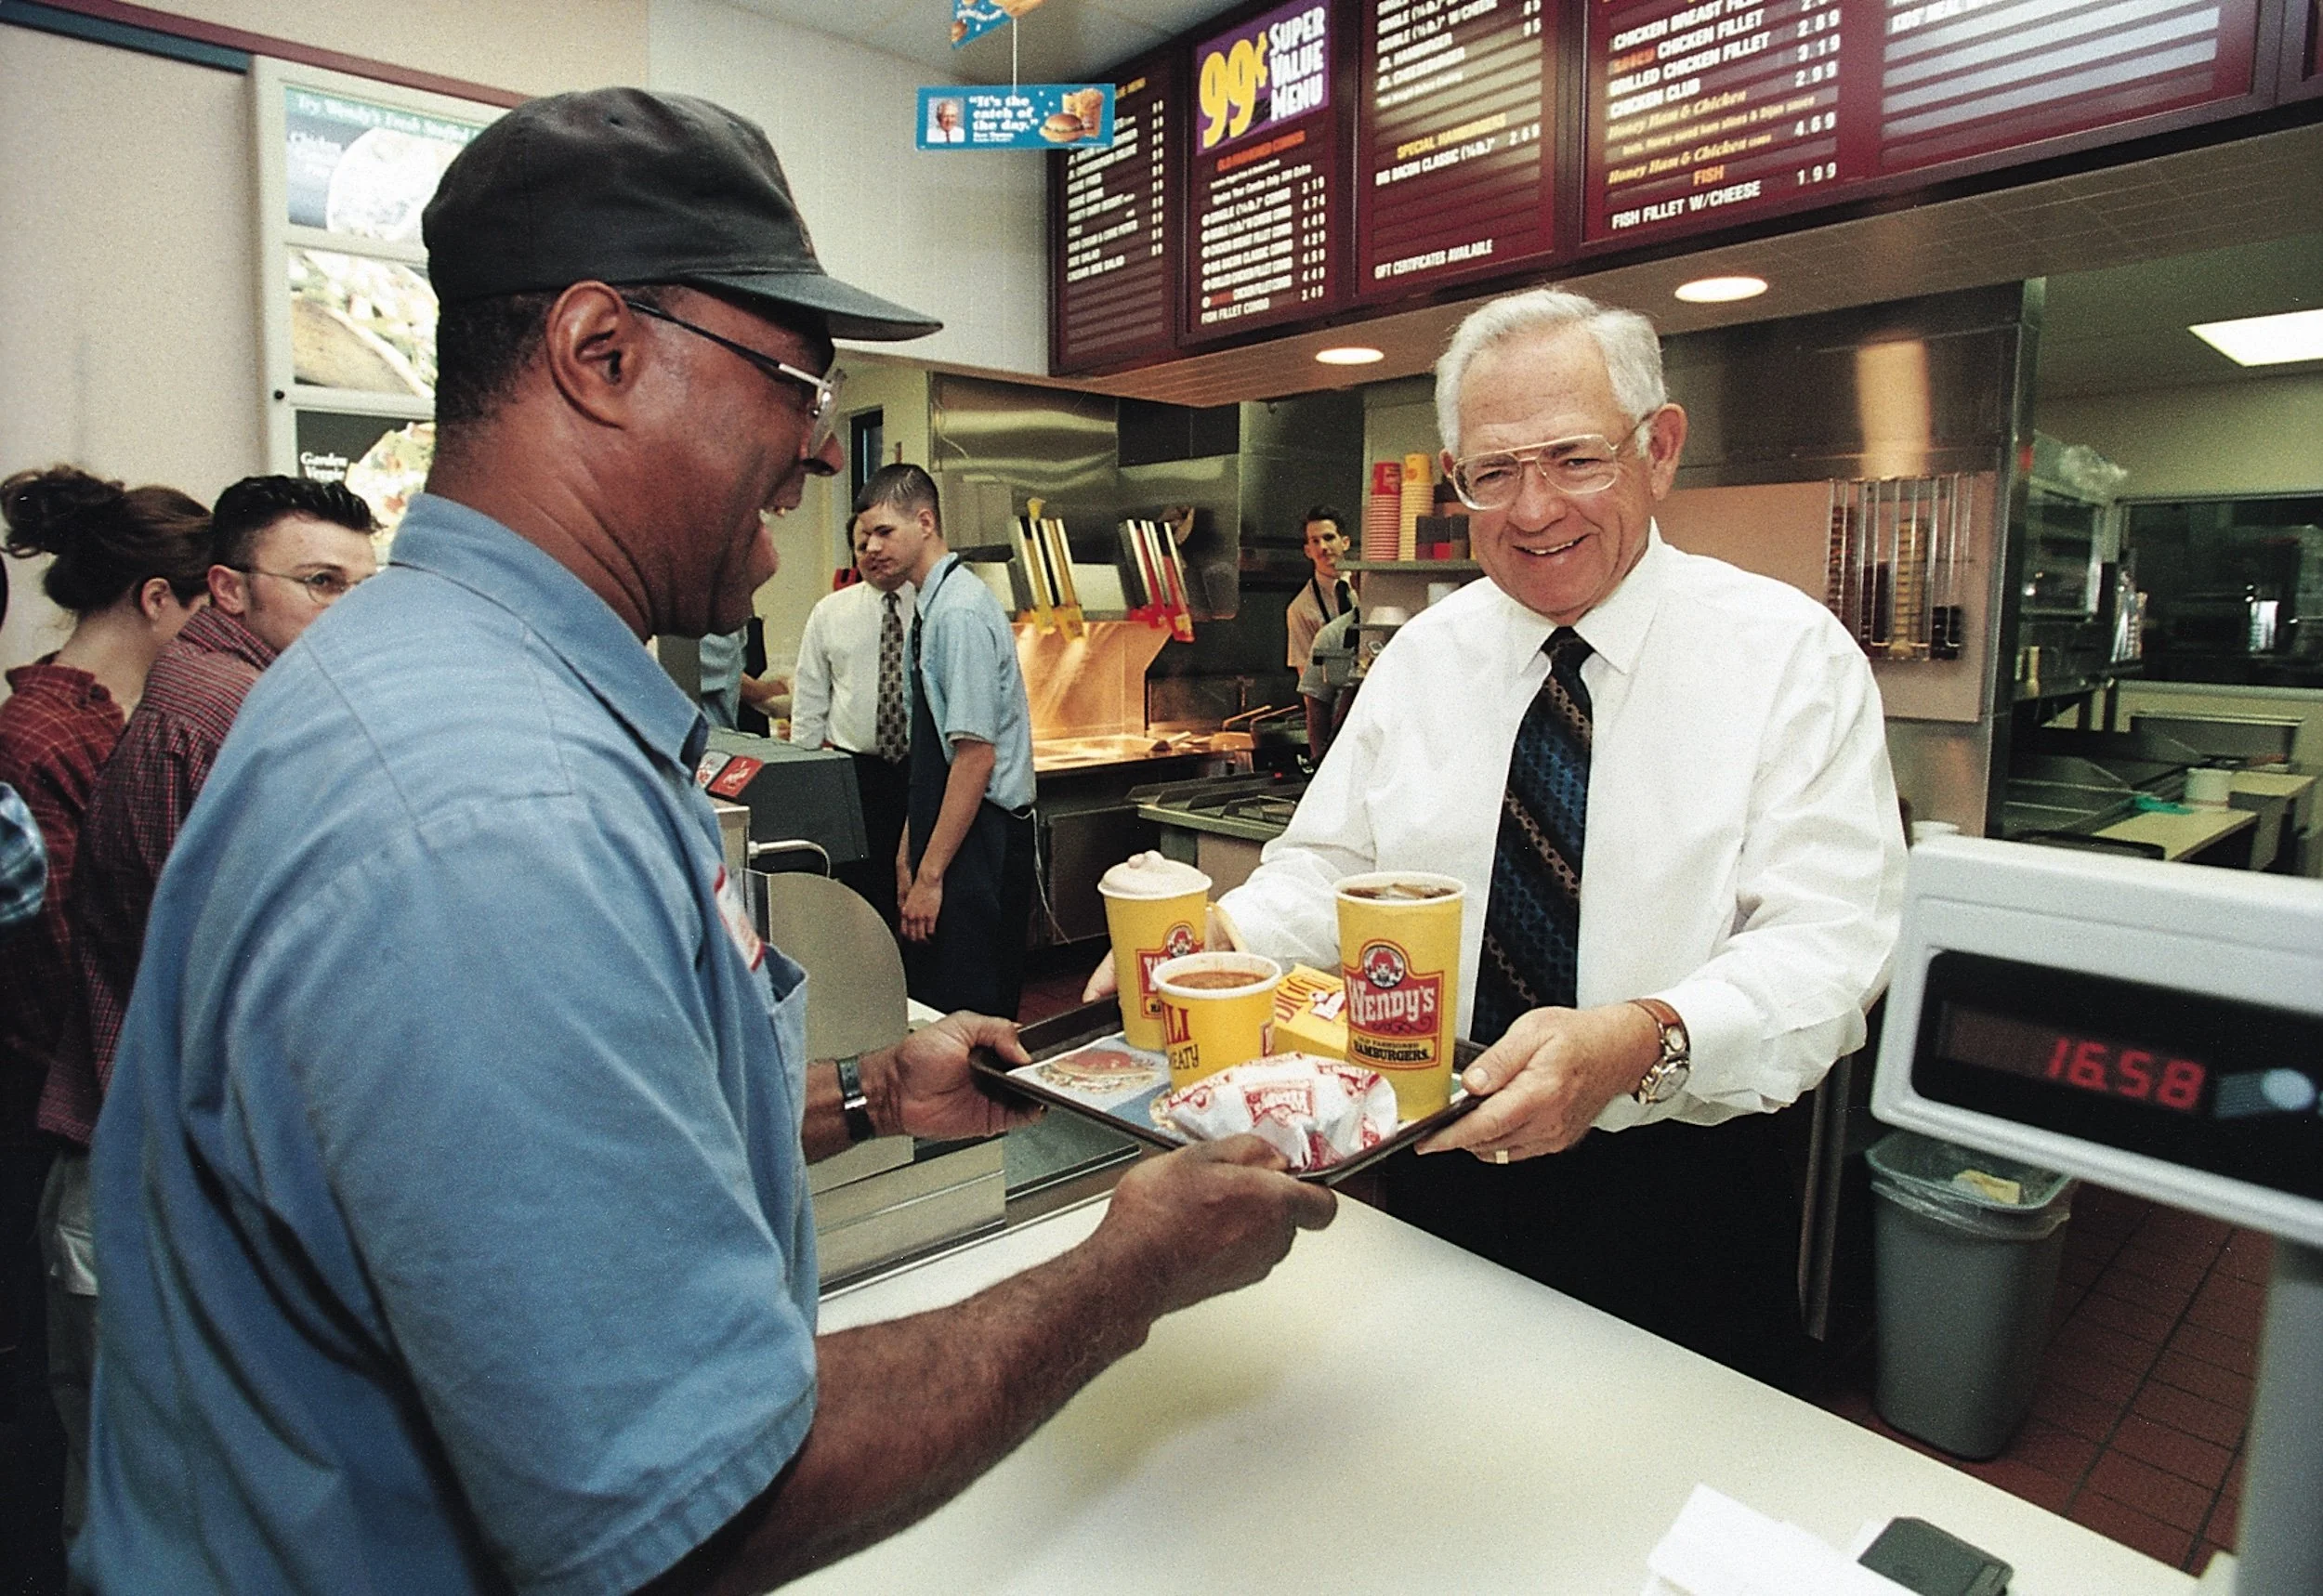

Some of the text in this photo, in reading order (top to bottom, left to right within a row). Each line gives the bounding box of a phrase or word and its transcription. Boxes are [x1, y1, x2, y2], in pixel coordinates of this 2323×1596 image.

[1269, 7, 1325, 57] SUPER
[1613, 19, 1668, 50] CHICKEN
[1671, 0, 1722, 33] BREAST
[1658, 26, 1713, 59] CHICKEN
[1717, 8, 1765, 39] FILLET
[1270, 39, 1324, 88] VALUE
[1609, 68, 1660, 97] GRILLED
[1662, 48, 1720, 80] CHICKEN
[1723, 33, 1771, 61] FILLET
[1005, 96, 1030, 106] the
[1270, 73, 1323, 122] MENU
[1609, 88, 1663, 120] CHICKEN
[1665, 78, 1701, 104] CLUB
[1693, 90, 1747, 117] Chicken
[973, 120, 997, 130] the
[1017, 107, 1034, 118] of
[1422, 149, 1459, 172] CLASSIC
[1693, 136, 1747, 162] Chicken
[1693, 164, 1724, 186] FISH
[1611, 206, 1640, 230] FISH
[1643, 198, 1684, 223] FILLET
[1689, 180, 1762, 212] W/CHEESE
[1448, 239, 1492, 262] AVAILABLE
[301, 451, 348, 467] Garden
